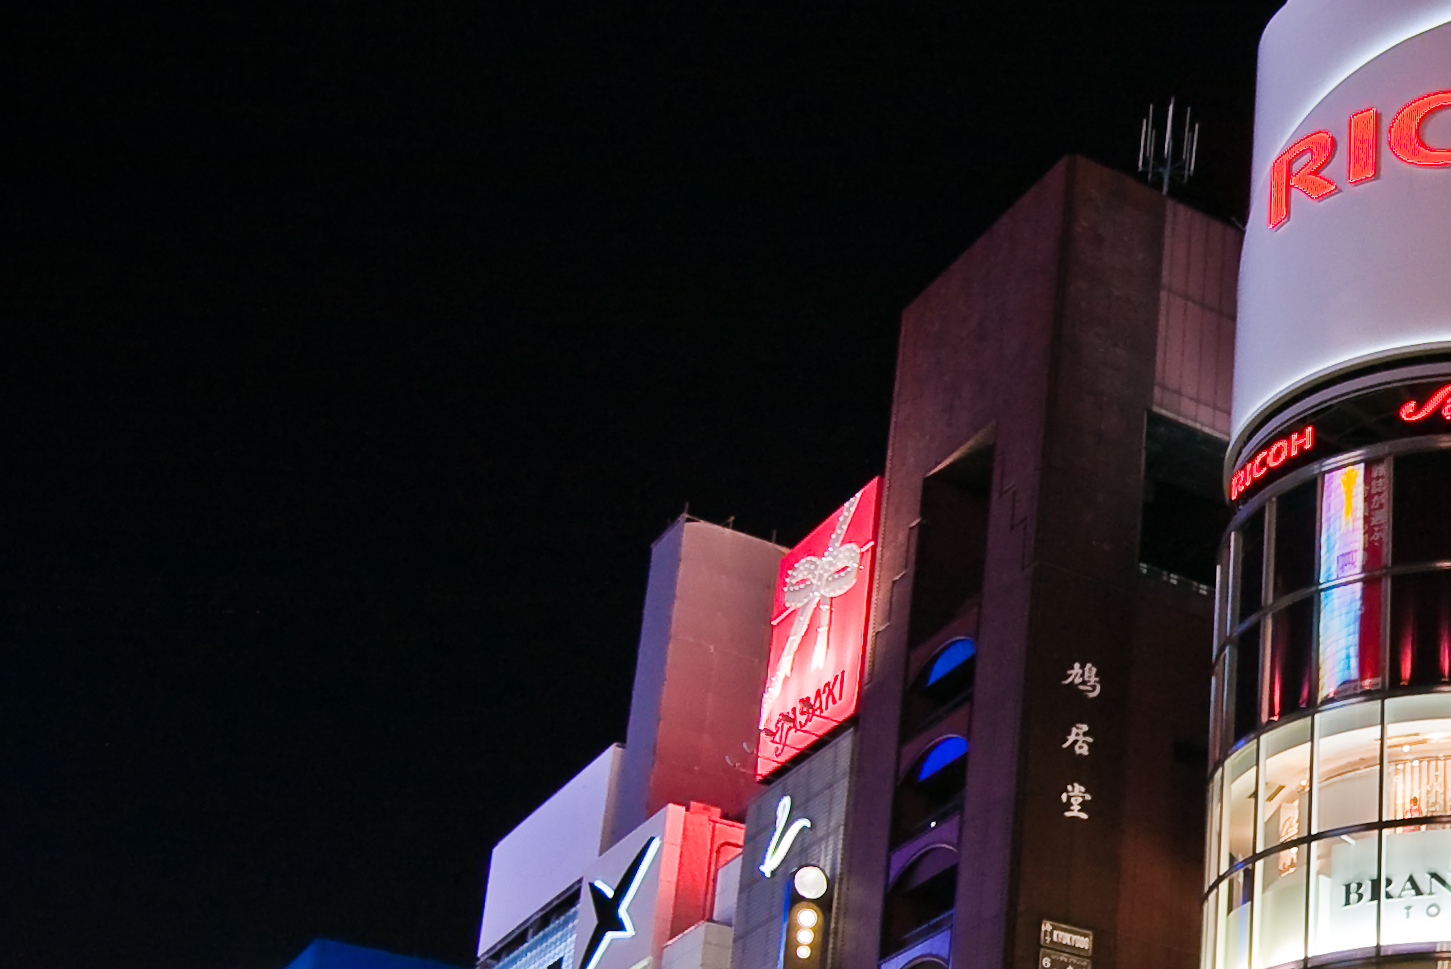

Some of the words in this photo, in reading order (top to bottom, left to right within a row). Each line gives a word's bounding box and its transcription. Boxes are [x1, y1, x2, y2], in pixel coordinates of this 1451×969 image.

[1230, 425, 1314, 499] RICOH
[1061, 662, 1101, 820] 鳩居堂
[1042, 957, 1051, 968] 6
